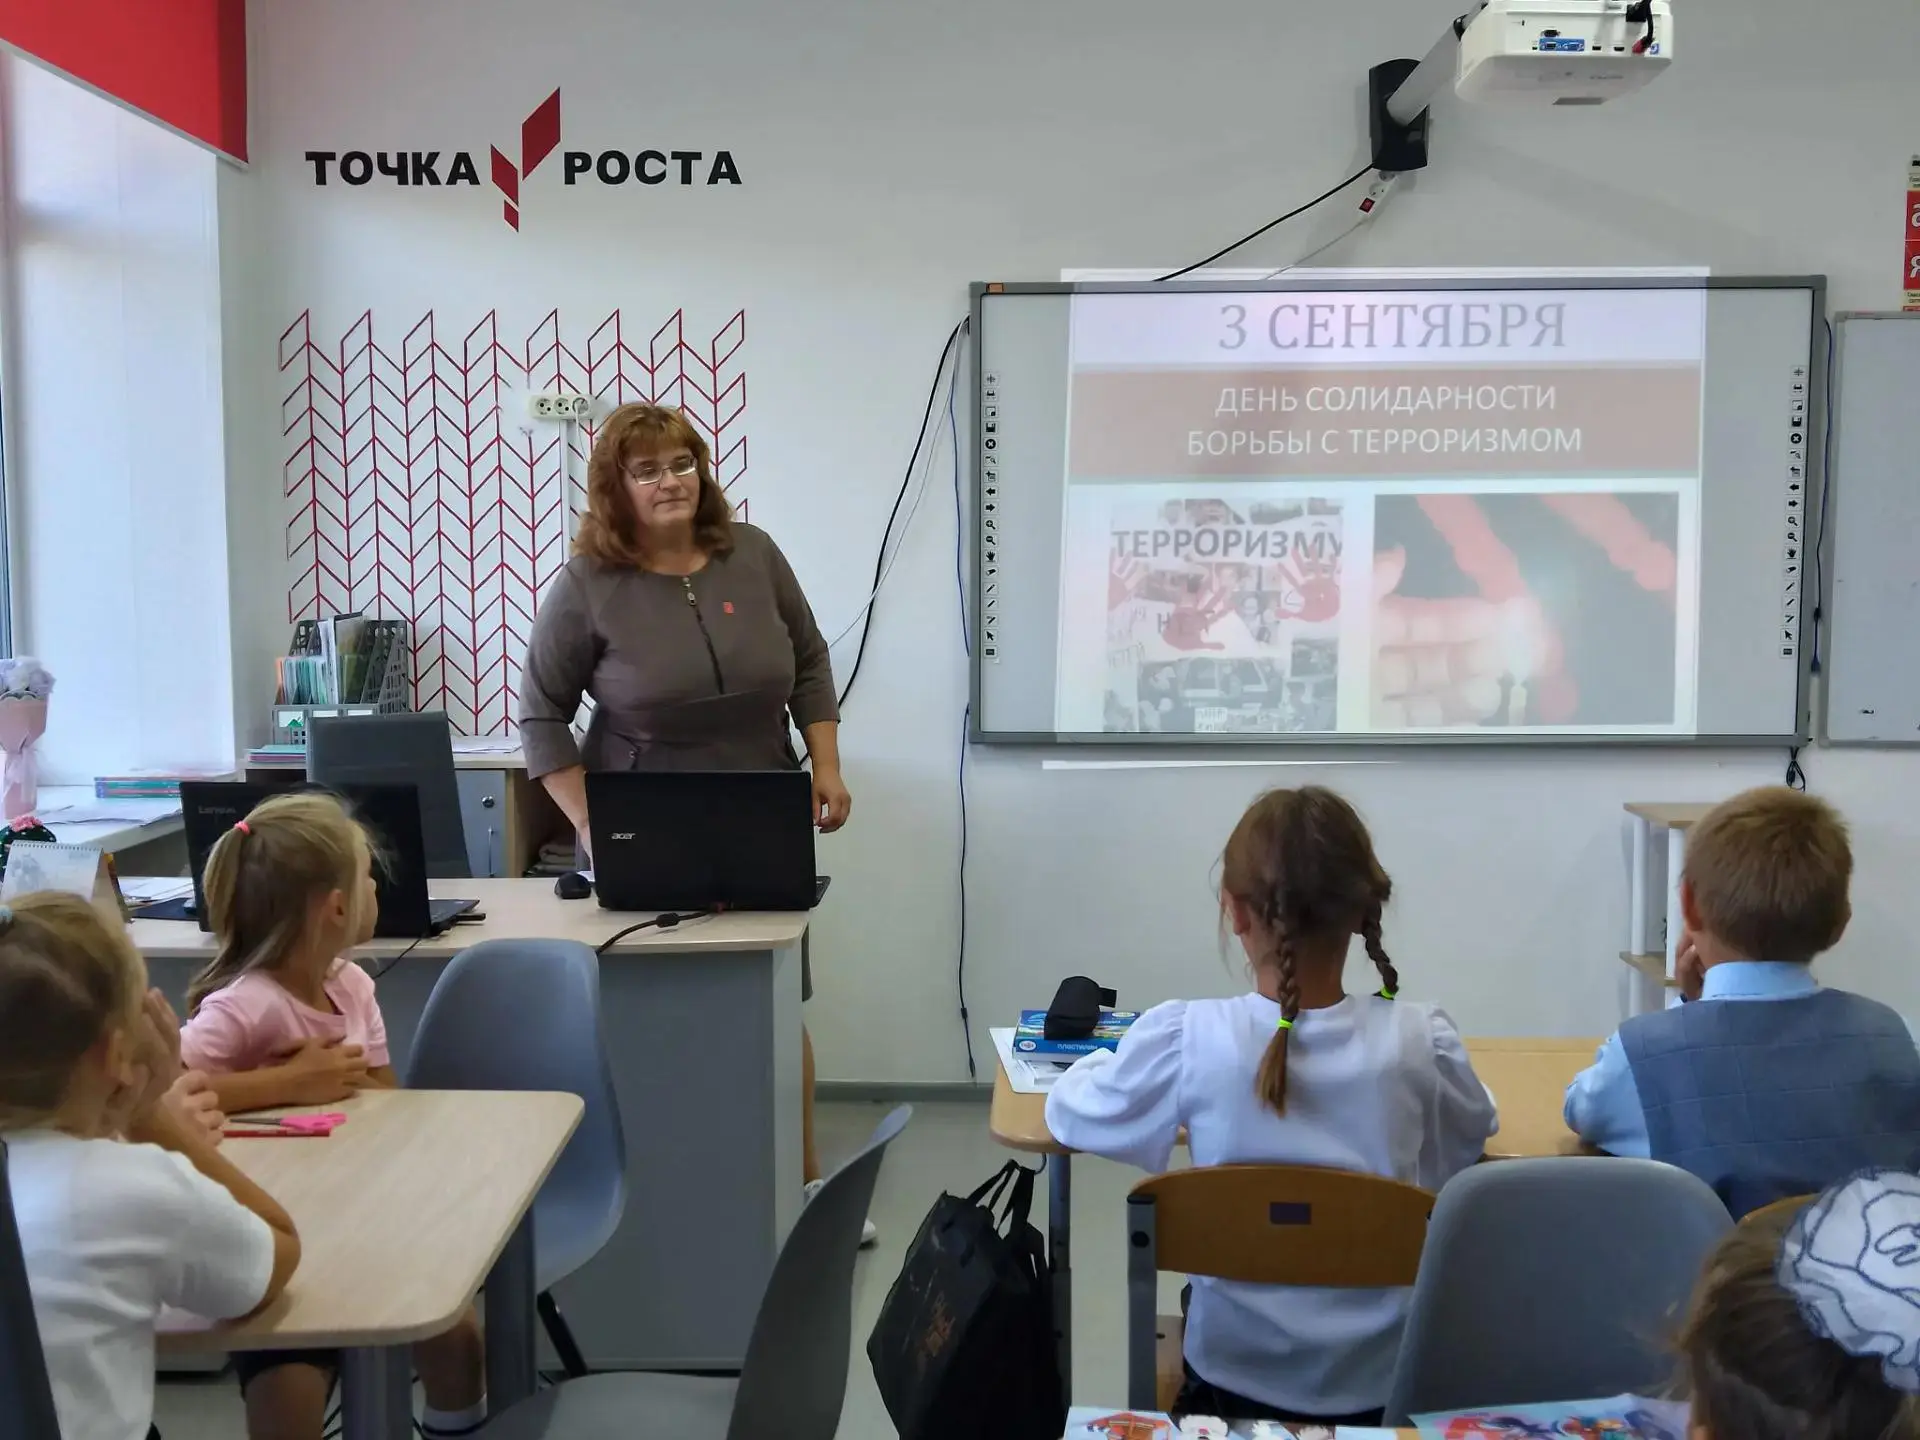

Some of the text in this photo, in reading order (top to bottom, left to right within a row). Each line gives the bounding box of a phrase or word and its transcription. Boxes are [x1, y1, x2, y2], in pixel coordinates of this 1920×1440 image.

[305, 150, 743, 186] ТОЧКА РОСТА
[1219, 303, 1567, 350] 3 СЕНТЯБРЯ
[1215, 385, 1556, 418] ДЕНЬ СОЛИДАРНОСТИ
[1188, 428, 1582, 455] БОРЬБЫ С ТЕРРОРИЗМОМ
[611, 832, 636, 840] acer
